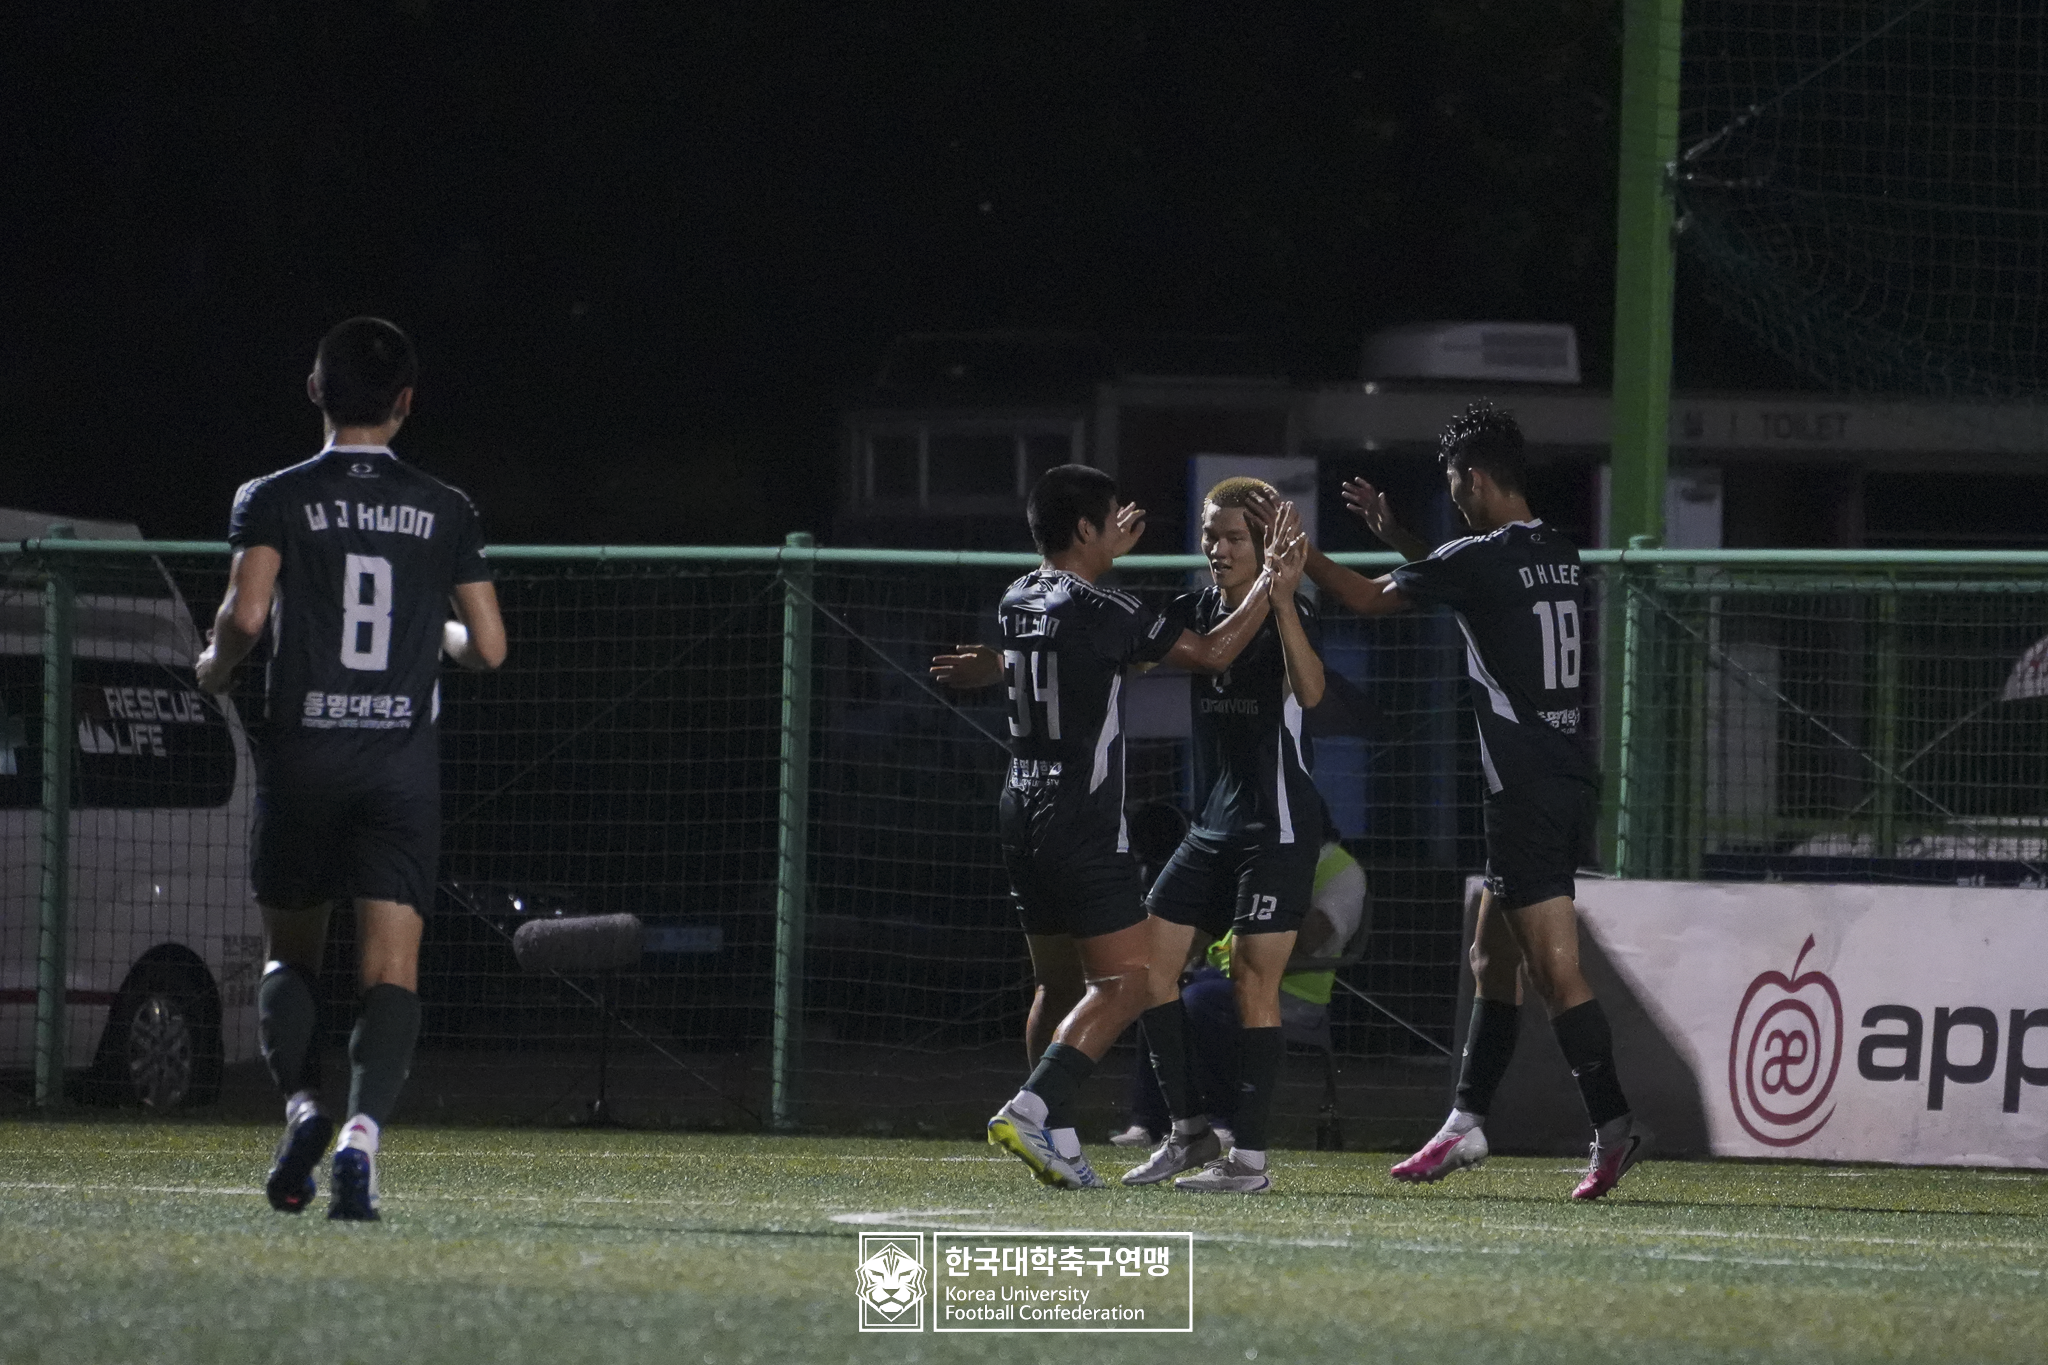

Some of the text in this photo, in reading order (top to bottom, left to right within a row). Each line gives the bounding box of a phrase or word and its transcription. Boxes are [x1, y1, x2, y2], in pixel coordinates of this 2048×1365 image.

[1760, 412, 1851, 440] TOILET
[304, 500, 435, 540] W J KWON
[1519, 564, 1580, 588] D H LEE
[340, 552, 392, 671] 8
[1015, 614, 1027, 634] H
[1532, 600, 1581, 690] 18
[103, 687, 205, 723] RESCUE
[303, 691, 412, 718] 동명대학교
[1003, 649, 1061, 740] 34
[112, 722, 167, 757] LIFE
[1249, 893, 1277, 920] 12
[1857, 1004, 2048, 1114] app
